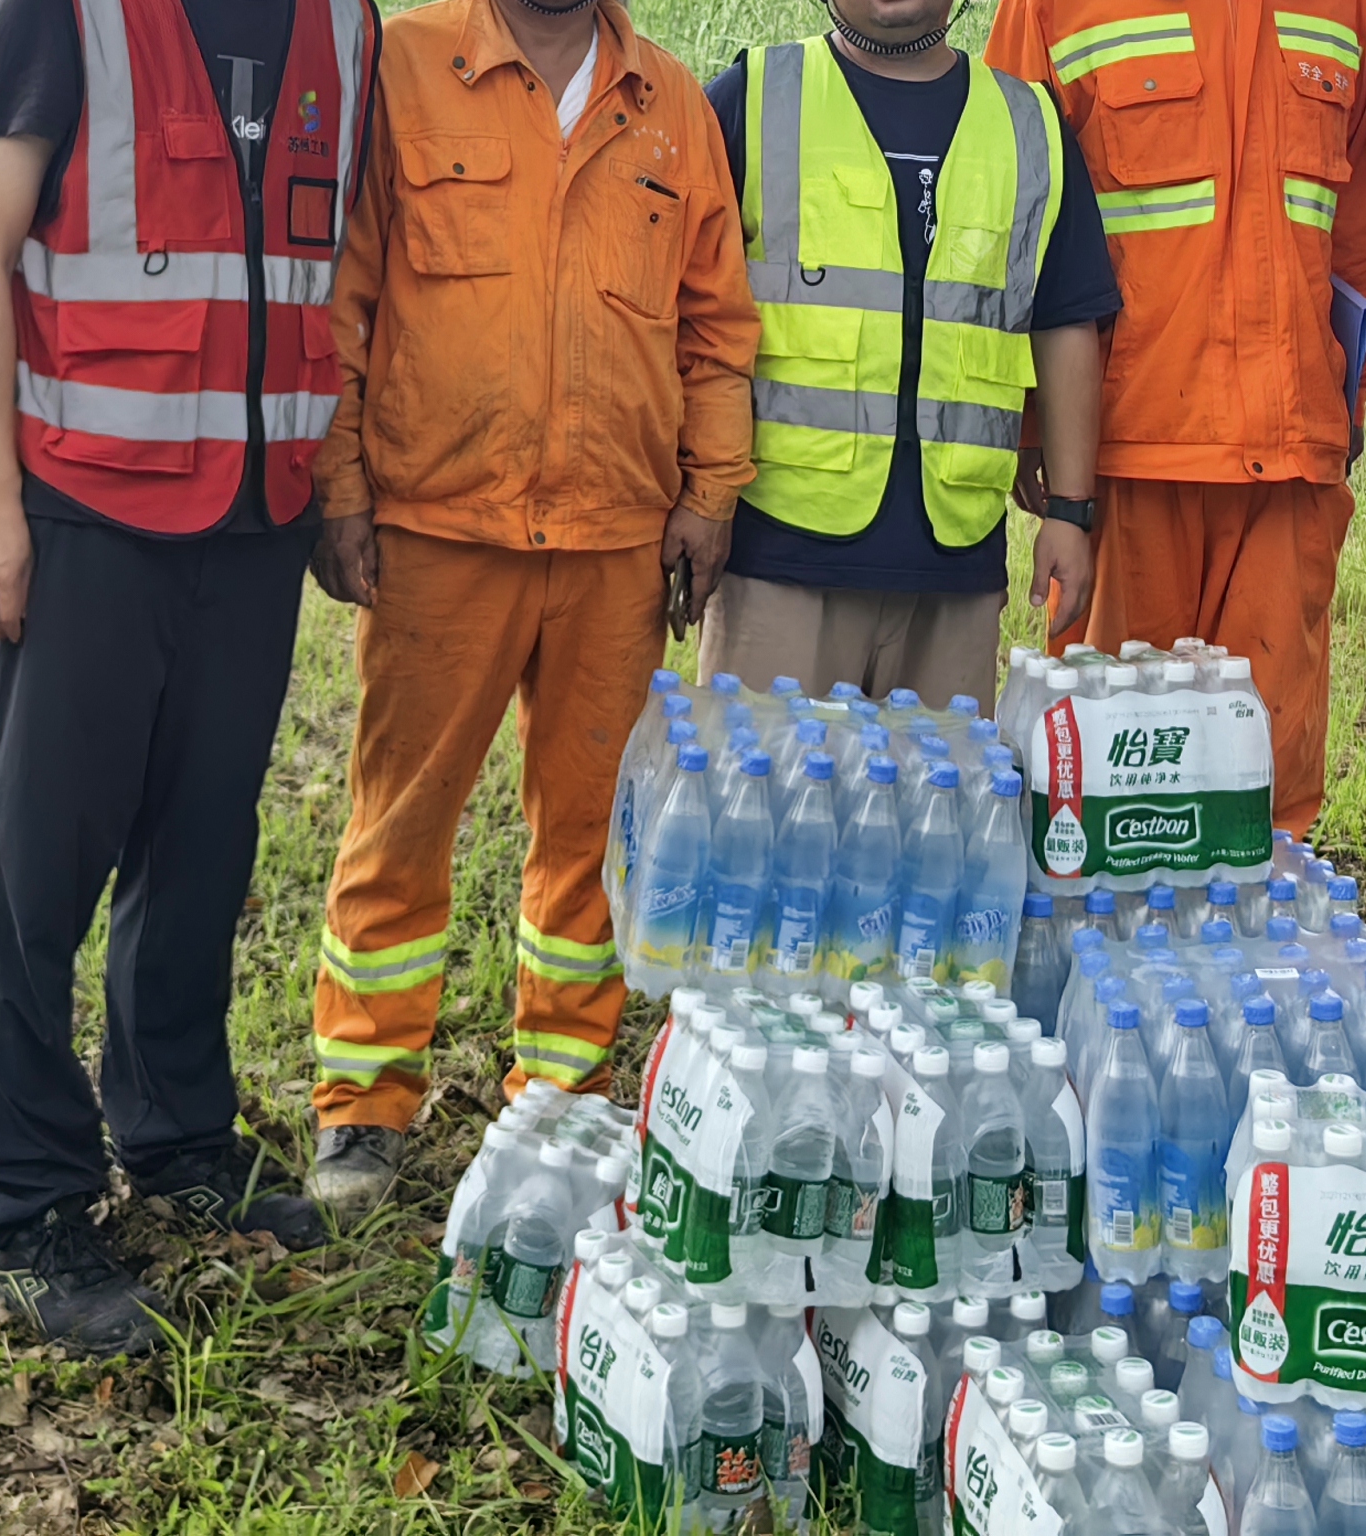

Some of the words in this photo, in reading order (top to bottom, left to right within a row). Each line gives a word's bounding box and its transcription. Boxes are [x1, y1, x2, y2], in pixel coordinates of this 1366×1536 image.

[1256, 1172, 1280, 1285] 整包更优惠
[1313, 1361, 1356, 1380] Purified
